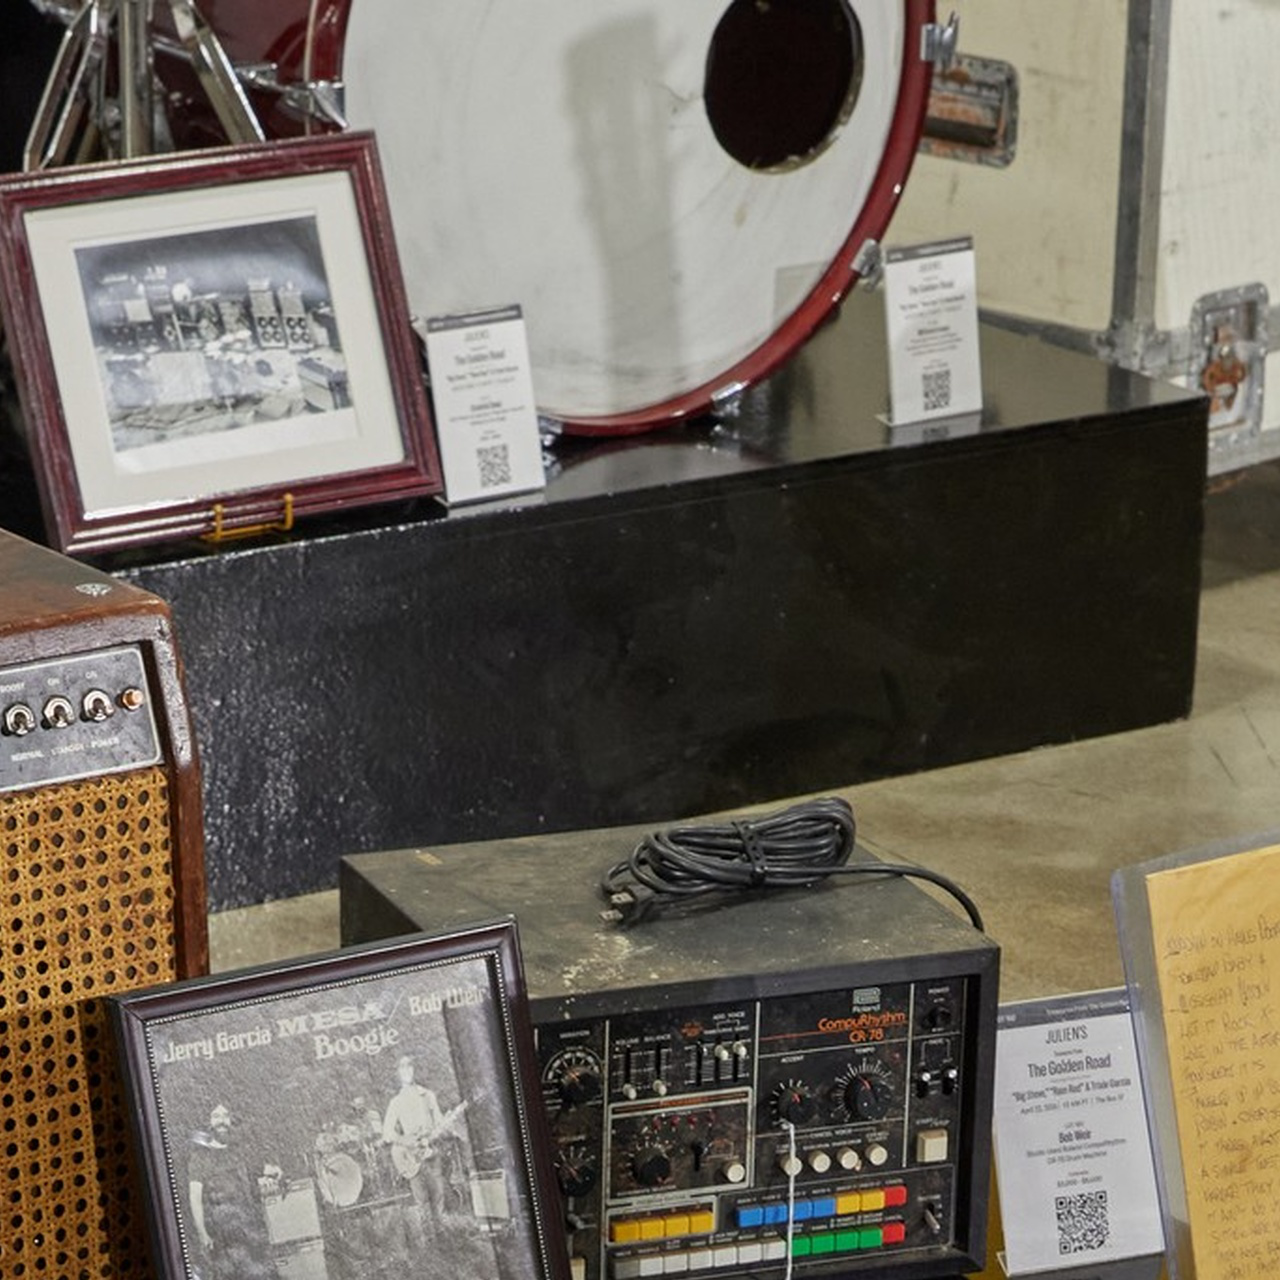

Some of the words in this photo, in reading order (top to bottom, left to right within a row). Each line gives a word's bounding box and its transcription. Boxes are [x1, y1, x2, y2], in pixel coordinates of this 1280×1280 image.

[163, 1037, 214, 1064] Jerry
[216, 1027, 272, 1053] Garcia
[276, 1003, 387, 1038] MESA
[410, 993, 444, 1017] Bob
[446, 985, 486, 1007] Weir
[1044, 1024, 1088, 1044] JULIEN'S
[314, 1025, 399, 1060] Boogie
[1027, 1061, 1047, 1078] The
[1047, 1056, 1085, 1076] Golden
[1085, 1052, 1111, 1070] Road
